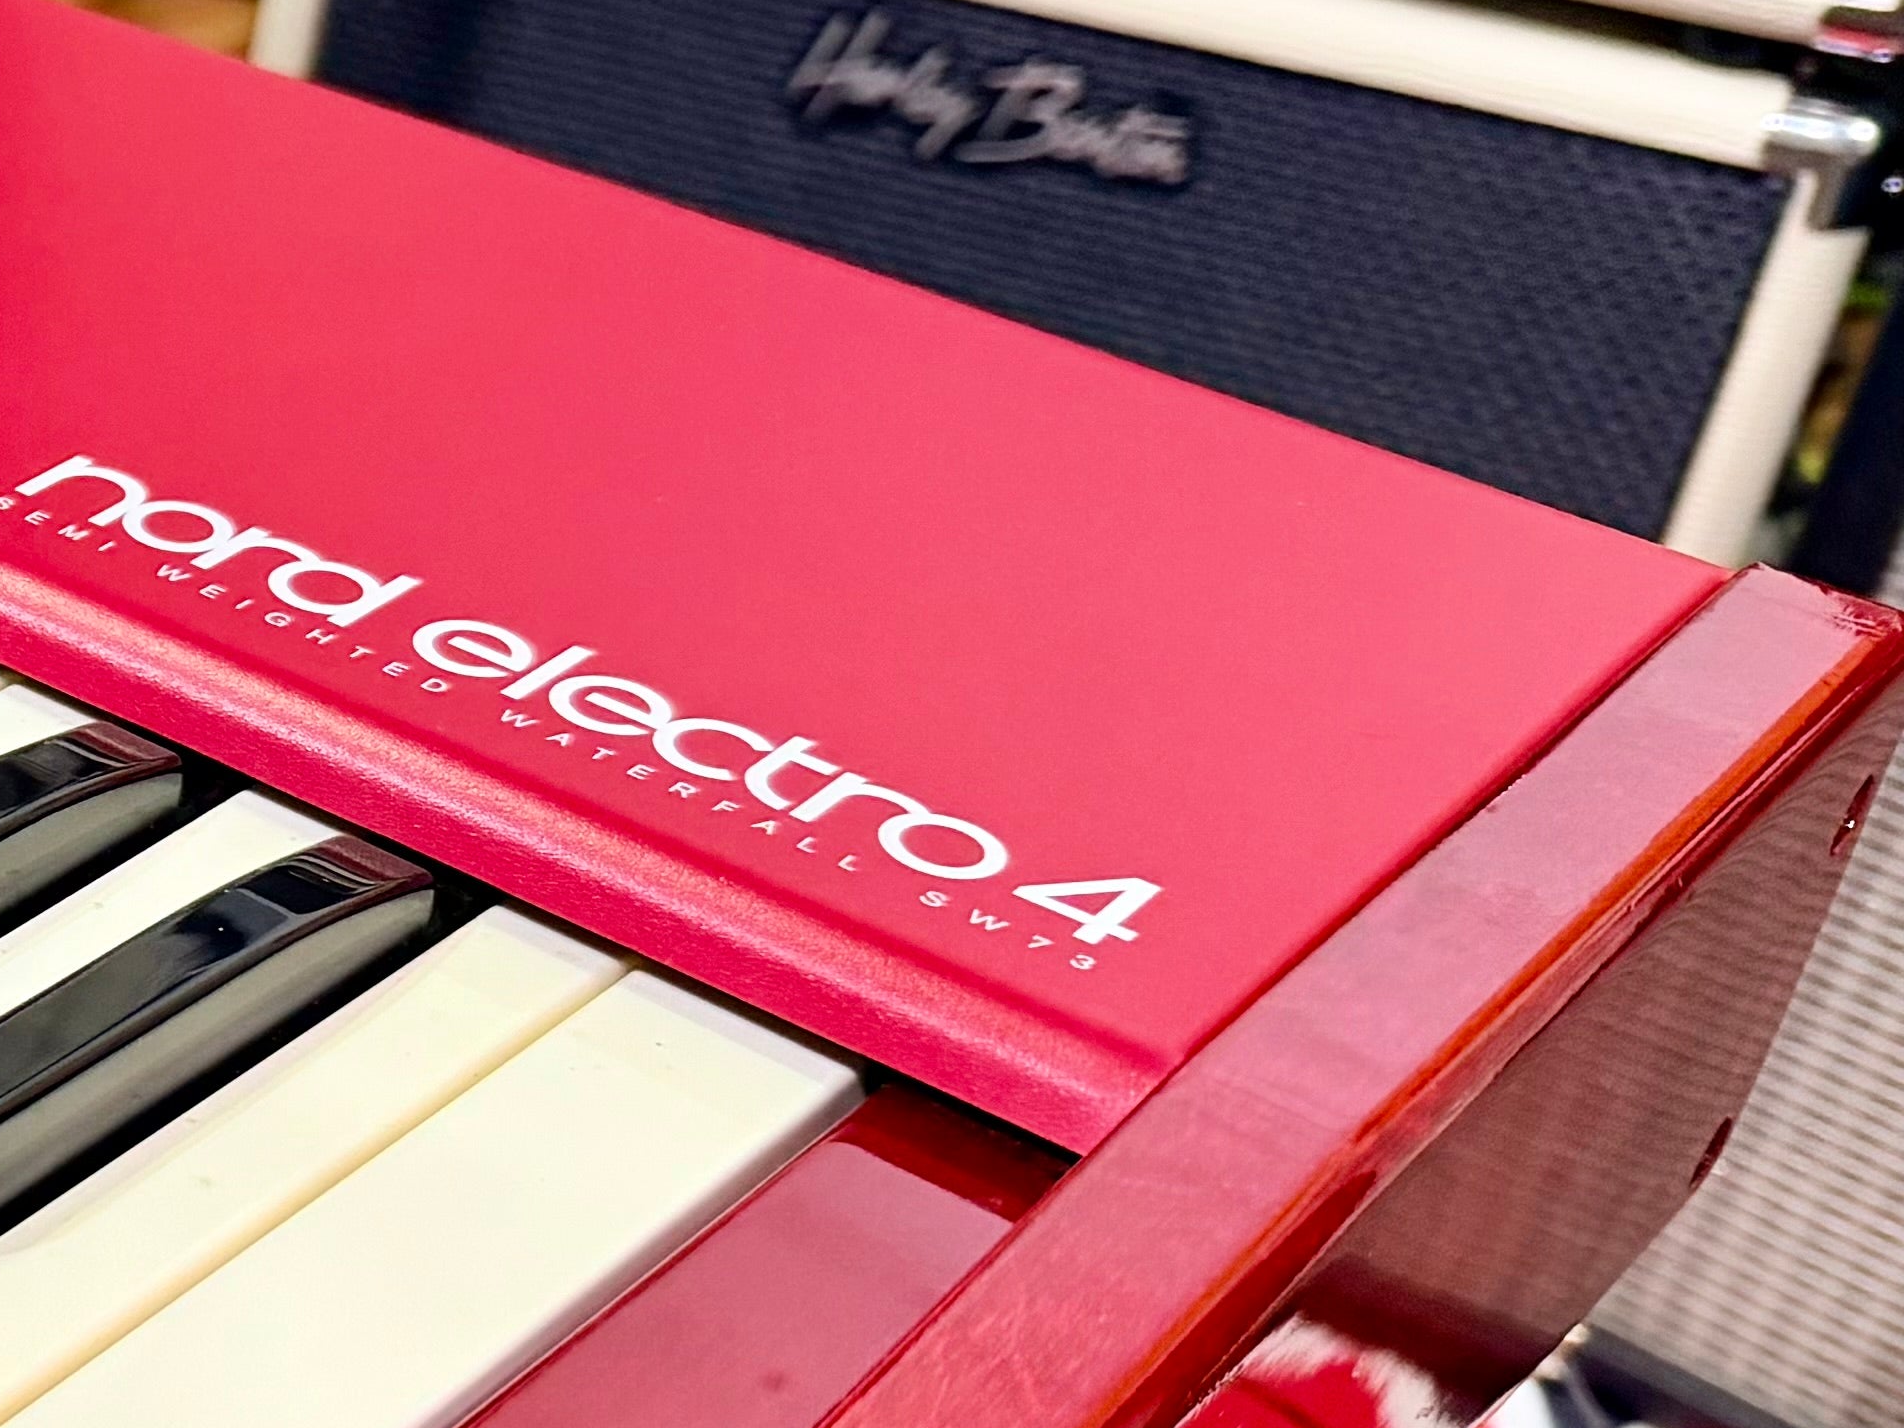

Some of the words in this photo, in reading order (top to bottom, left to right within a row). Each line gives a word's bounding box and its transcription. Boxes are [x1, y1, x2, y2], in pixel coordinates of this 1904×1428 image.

[15, 455, 423, 629] nord
[411, 619, 1011, 881] electro
[1011, 876, 1165, 946] 4
[156, 563, 450, 695] WEIGHTED
[499, 708, 863, 874] WATERFALL
[918, 889, 1098, 972] SW73
